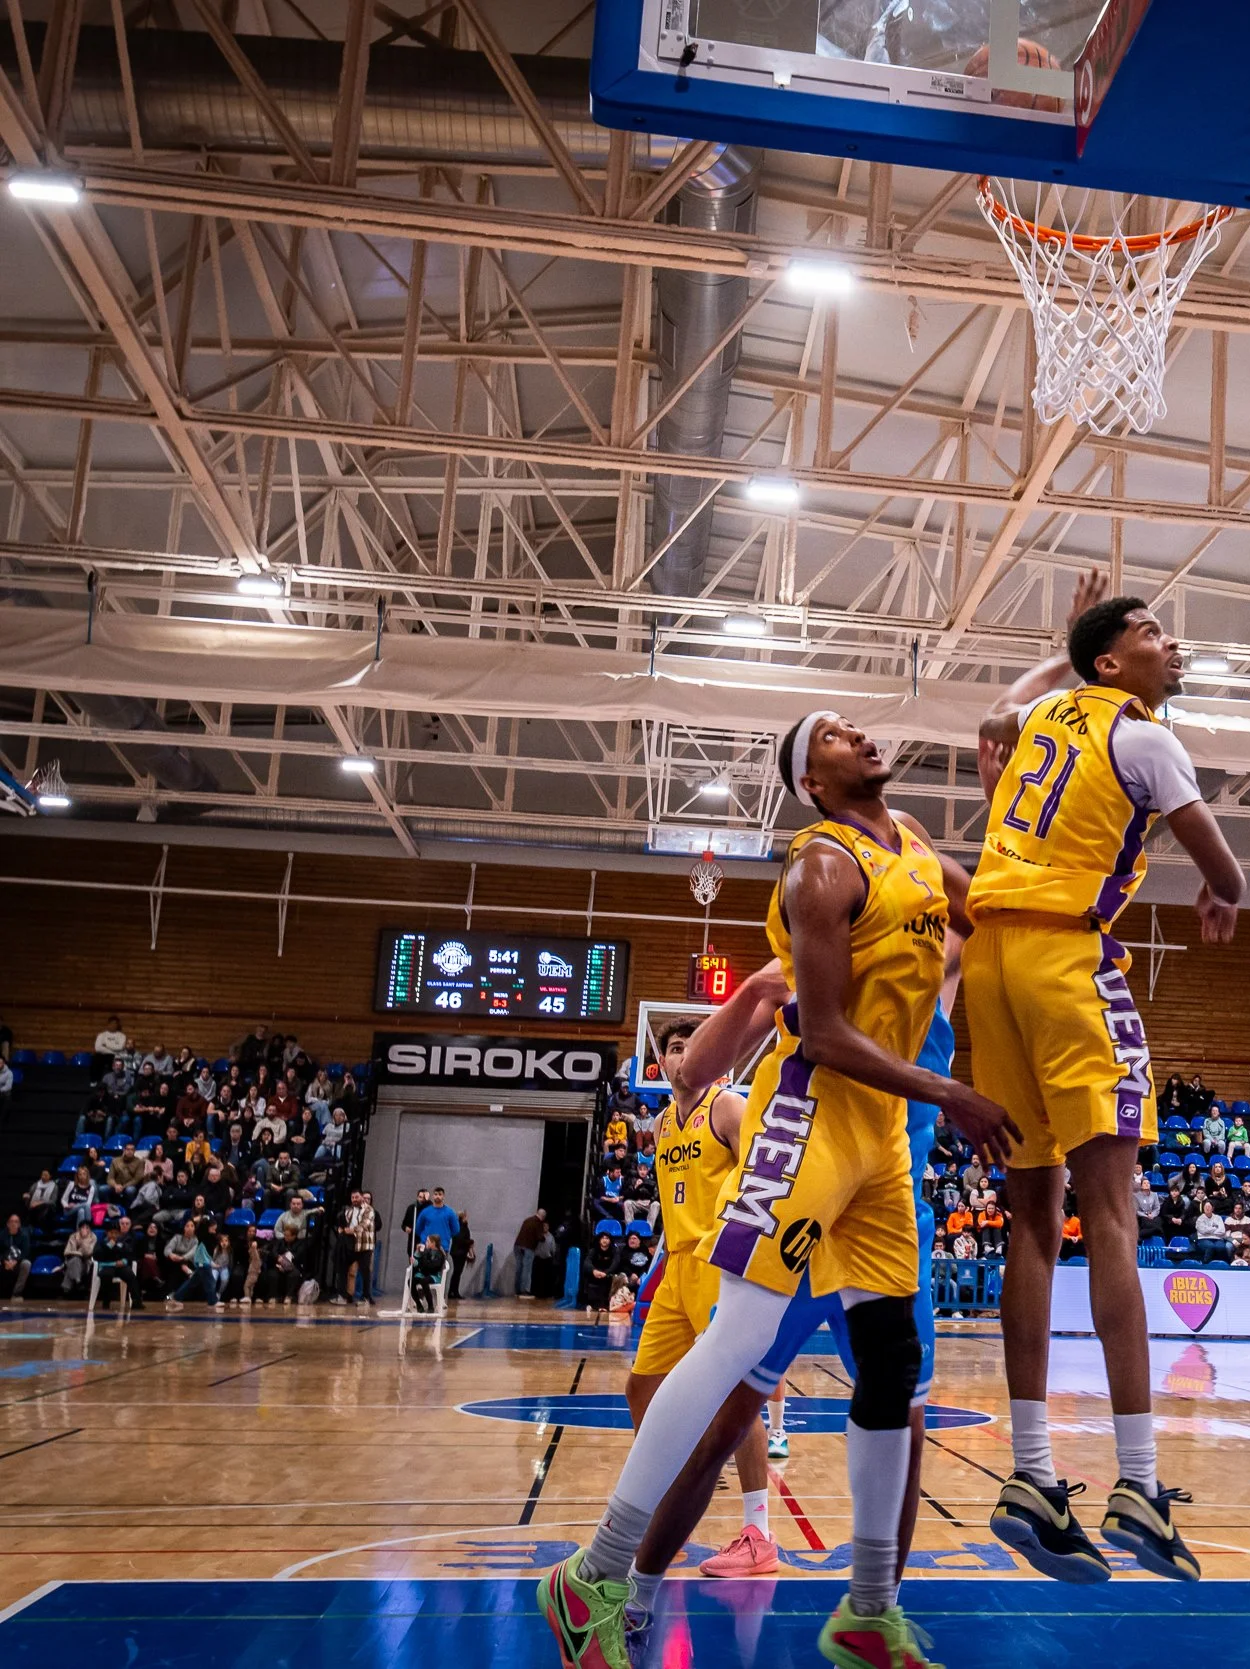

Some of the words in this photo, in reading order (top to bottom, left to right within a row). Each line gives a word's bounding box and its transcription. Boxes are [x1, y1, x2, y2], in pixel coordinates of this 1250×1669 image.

[1003, 733, 1081, 839] 21
[488, 949, 519, 964] 5:41
[538, 964, 573, 978] UEM
[712, 970, 727, 995] 8
[435, 991, 462, 1009] 46
[516, 993, 522, 1001] 4
[538, 997, 565, 1013] 45
[1091, 968, 1151, 1099] UEM
[387, 1043, 602, 1081] SIROKO
[717, 1091, 819, 1239] UEM
[674, 1181, 686, 1204] 8
[1172, 1276, 1208, 1290] IBIZA
[1169, 1289, 1213, 1305] ROCKS
